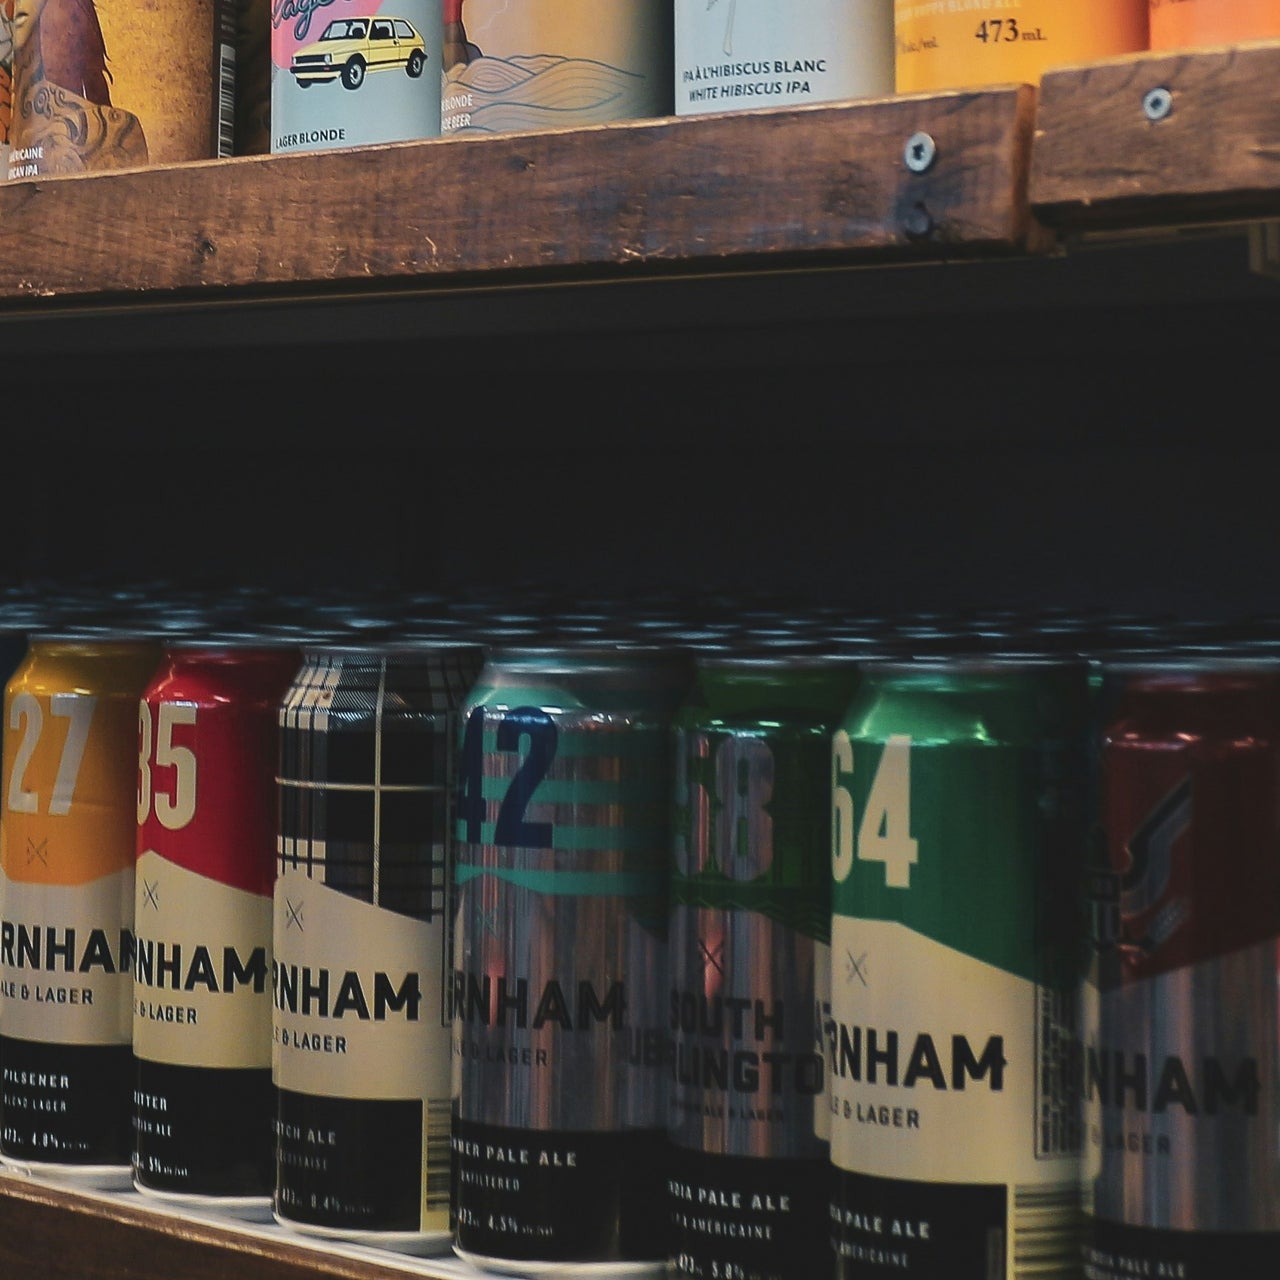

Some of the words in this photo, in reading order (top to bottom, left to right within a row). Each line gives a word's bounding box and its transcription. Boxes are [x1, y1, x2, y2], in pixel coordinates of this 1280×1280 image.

[974, 19, 1018, 44] 473
[774, 59, 827, 74] BLANC
[689, 86, 718, 102] WHITE
[720, 81, 782, 98] HIBISCUS
[786, 81, 811, 94] IPA
[275, 132, 298, 150] LAGER
[299, 128, 346, 145] BLONDE
[8, 692, 98, 816] 27
[458, 706, 558, 849] 42
[832, 728, 918, 888] 64
[35, 985, 94, 1005] LAGER
[149, 1005, 198, 1025] LAGER
[294, 1031, 347, 1055] LAGER
[485, 1044, 548, 1068] LAGER
[3, 1067, 69, 1089] PILSENER
[32, 1095, 67, 1113] LAGER
[856, 1101, 920, 1129] LAGER
[307, 1128, 336, 1146] ALE
[486, 1145, 529, 1165] PALE
[538, 1150, 577, 1168] ALE
[698, 1187, 741, 1210] PALE
[751, 1194, 790, 1212] ALE
[846, 1208, 883, 1234] PALE
[891, 1219, 931, 1240] ALE
